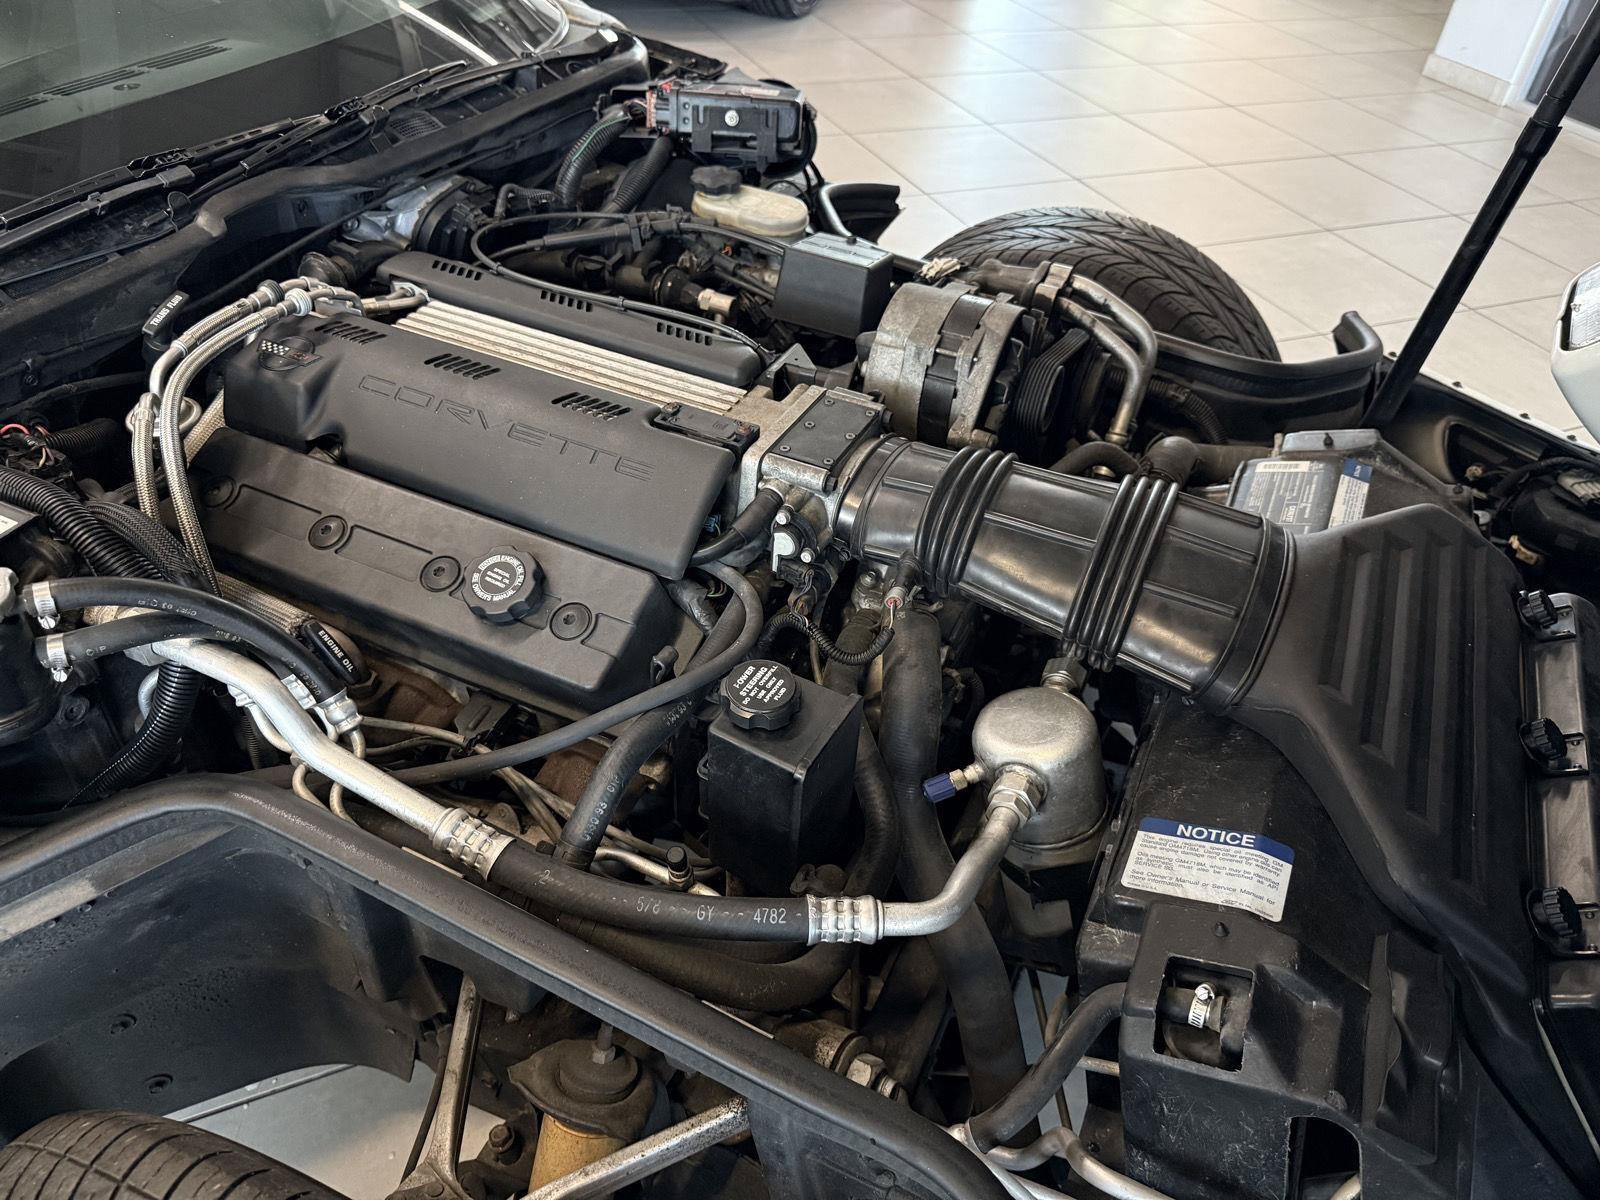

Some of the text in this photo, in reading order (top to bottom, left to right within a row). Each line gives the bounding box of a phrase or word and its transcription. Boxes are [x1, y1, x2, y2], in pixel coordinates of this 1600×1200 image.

[150, 308, 170, 326] TRANS
[358, 374, 656, 482] CORVETTE
[318, 630, 354, 673] ENGINE OIL
[740, 667, 768, 696] STEERING
[749, 687, 759, 696] NOT
[1176, 824, 1256, 847] NOTICE
[1175, 877, 1200, 886] Manual
[1211, 884, 1237, 892] Service
[1240, 888, 1264, 901] Manual
[753, 908, 787, 924] 4782
